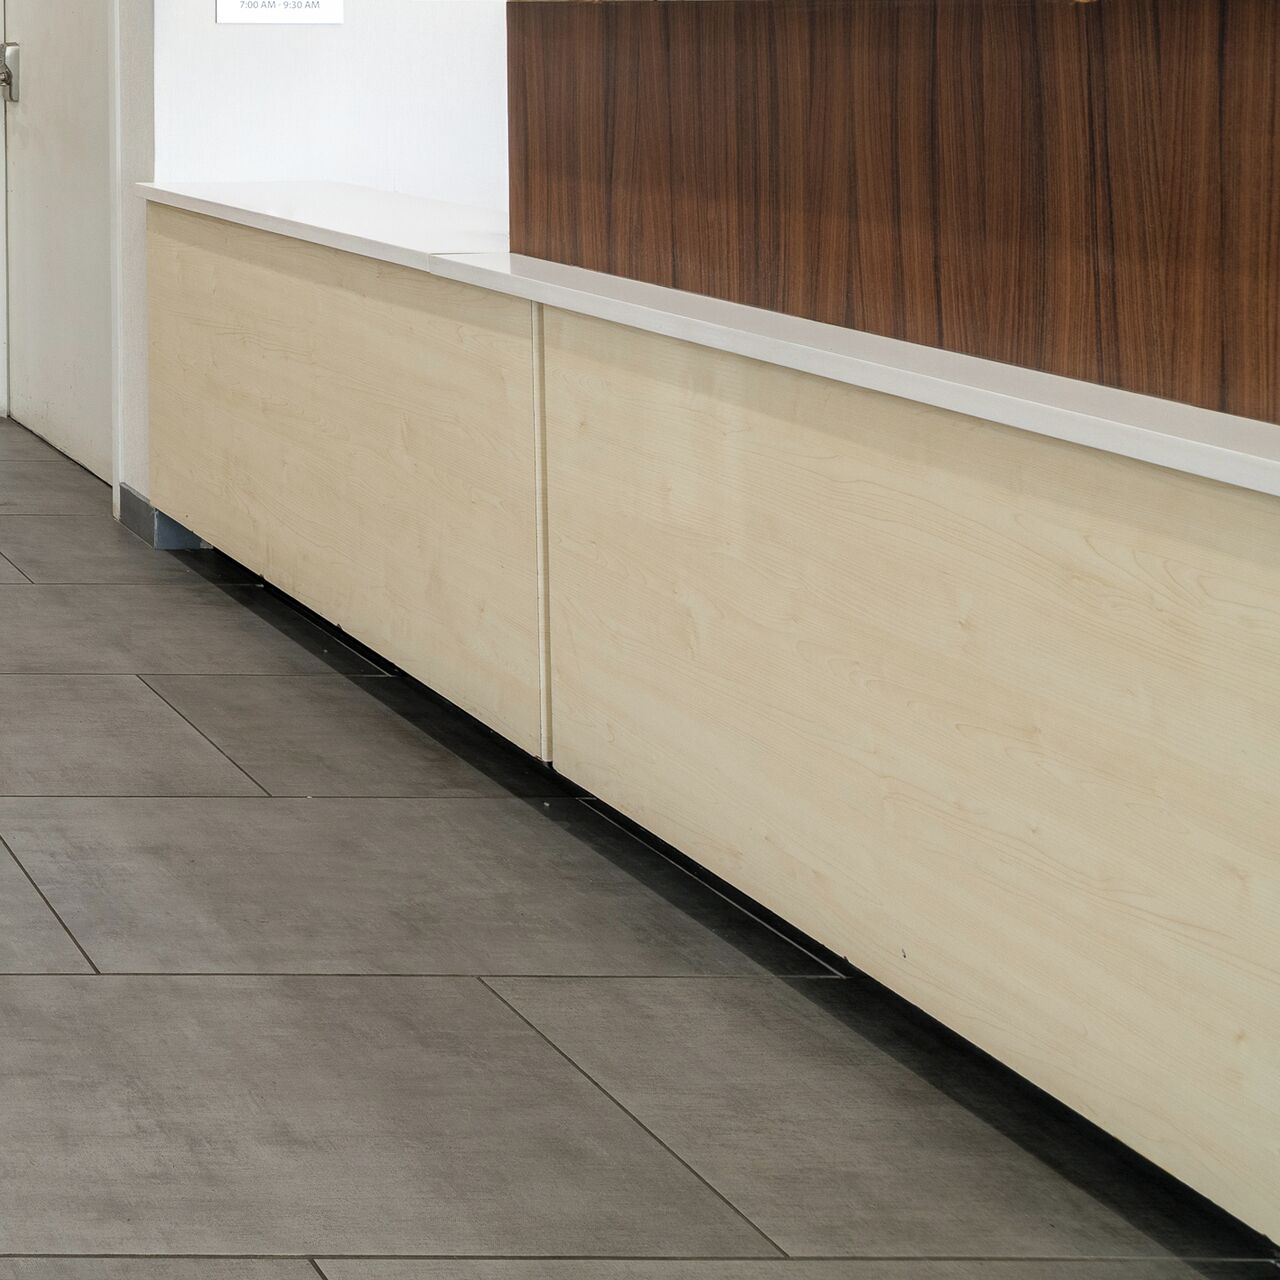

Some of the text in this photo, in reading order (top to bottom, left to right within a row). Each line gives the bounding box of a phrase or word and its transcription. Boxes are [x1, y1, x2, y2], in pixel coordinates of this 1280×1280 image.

[240, 1, 259, 9] 7:00
[261, 1, 276, 9] AM
[283, 1, 302, 9] 9:30
[304, 1, 320, 9] AM
